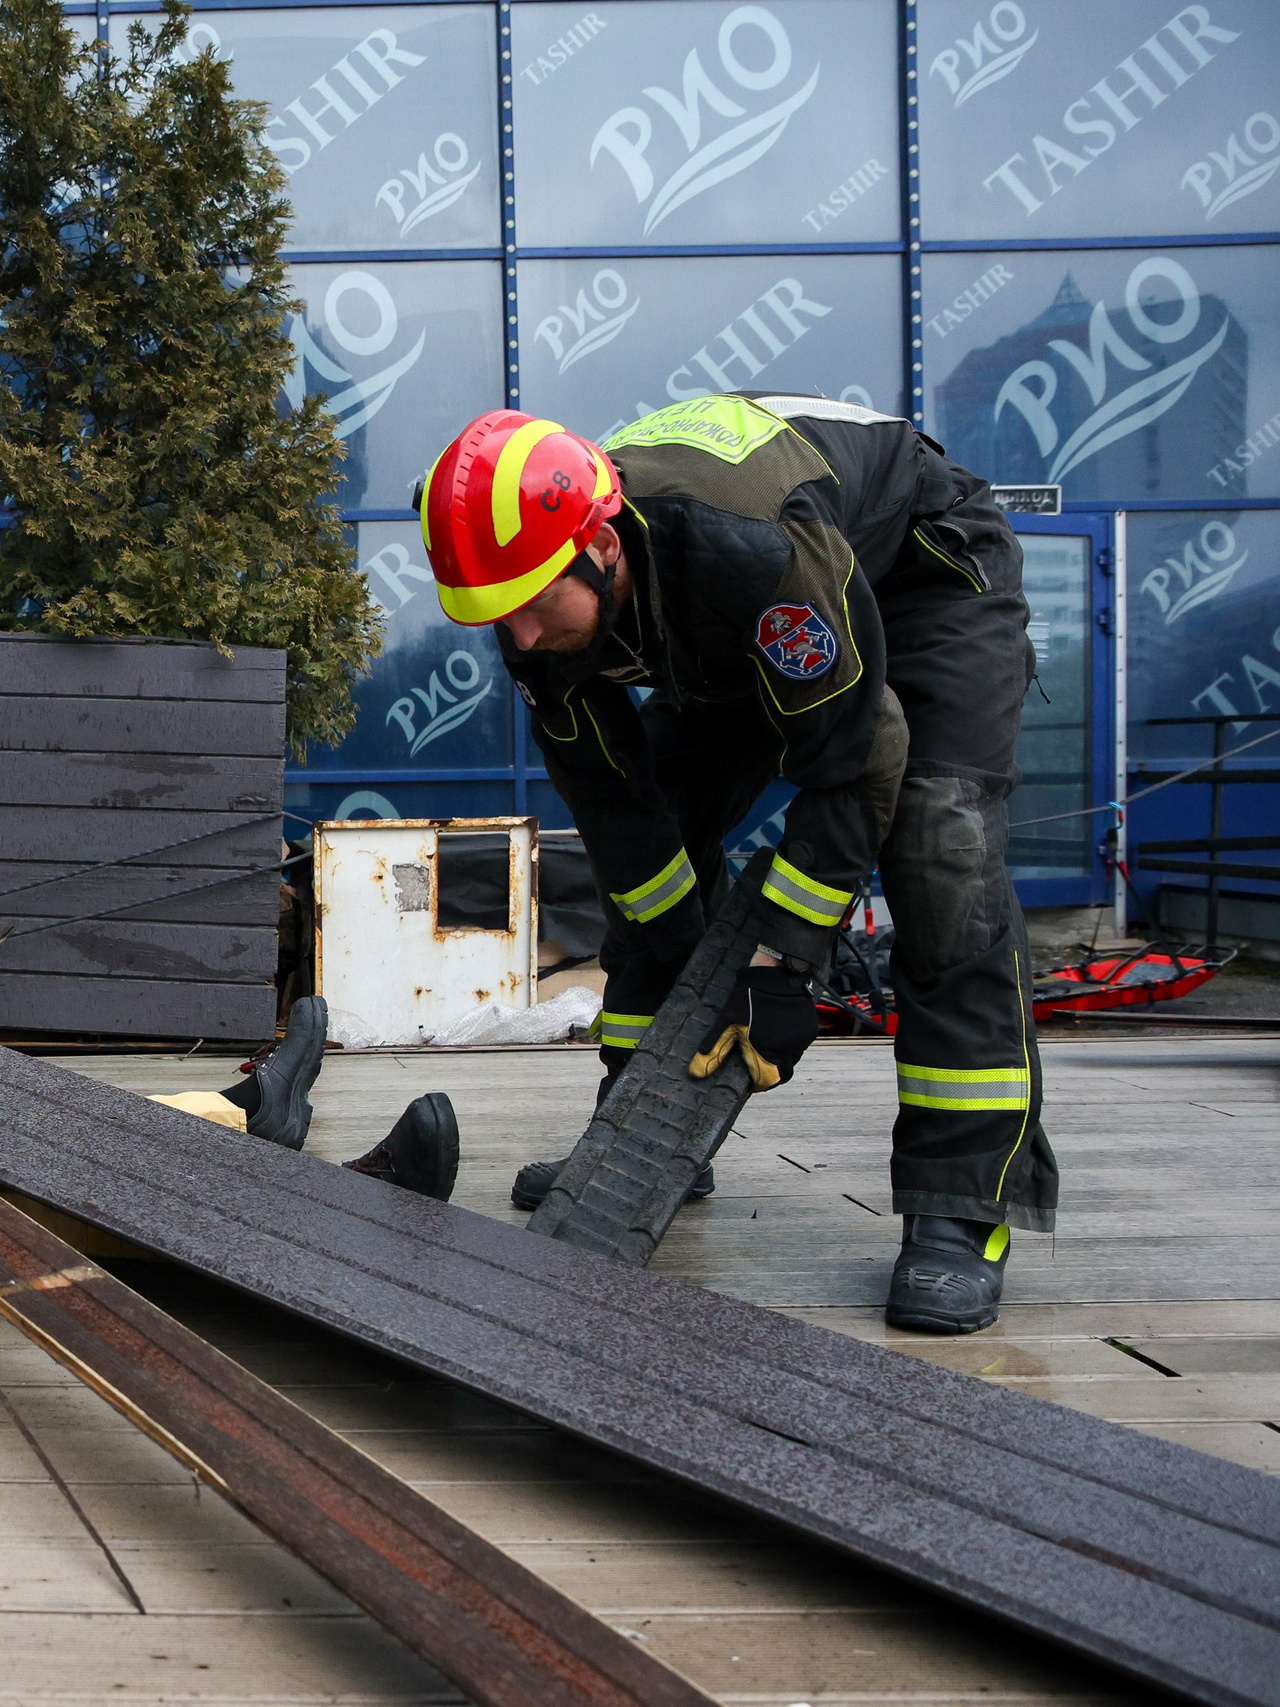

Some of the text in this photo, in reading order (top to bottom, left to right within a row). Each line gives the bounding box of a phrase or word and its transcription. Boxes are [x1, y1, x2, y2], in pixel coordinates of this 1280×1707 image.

[520, 12, 608, 88] TASHIR
[259, 28, 428, 175] SHIR
[590, 6, 792, 204] РИО
[983, 4, 1242, 217] TASHIR
[801, 158, 890, 233] TASHIR
[926, 263, 1014, 338] TASHIR
[1206, 413, 1280, 487] TASHI
